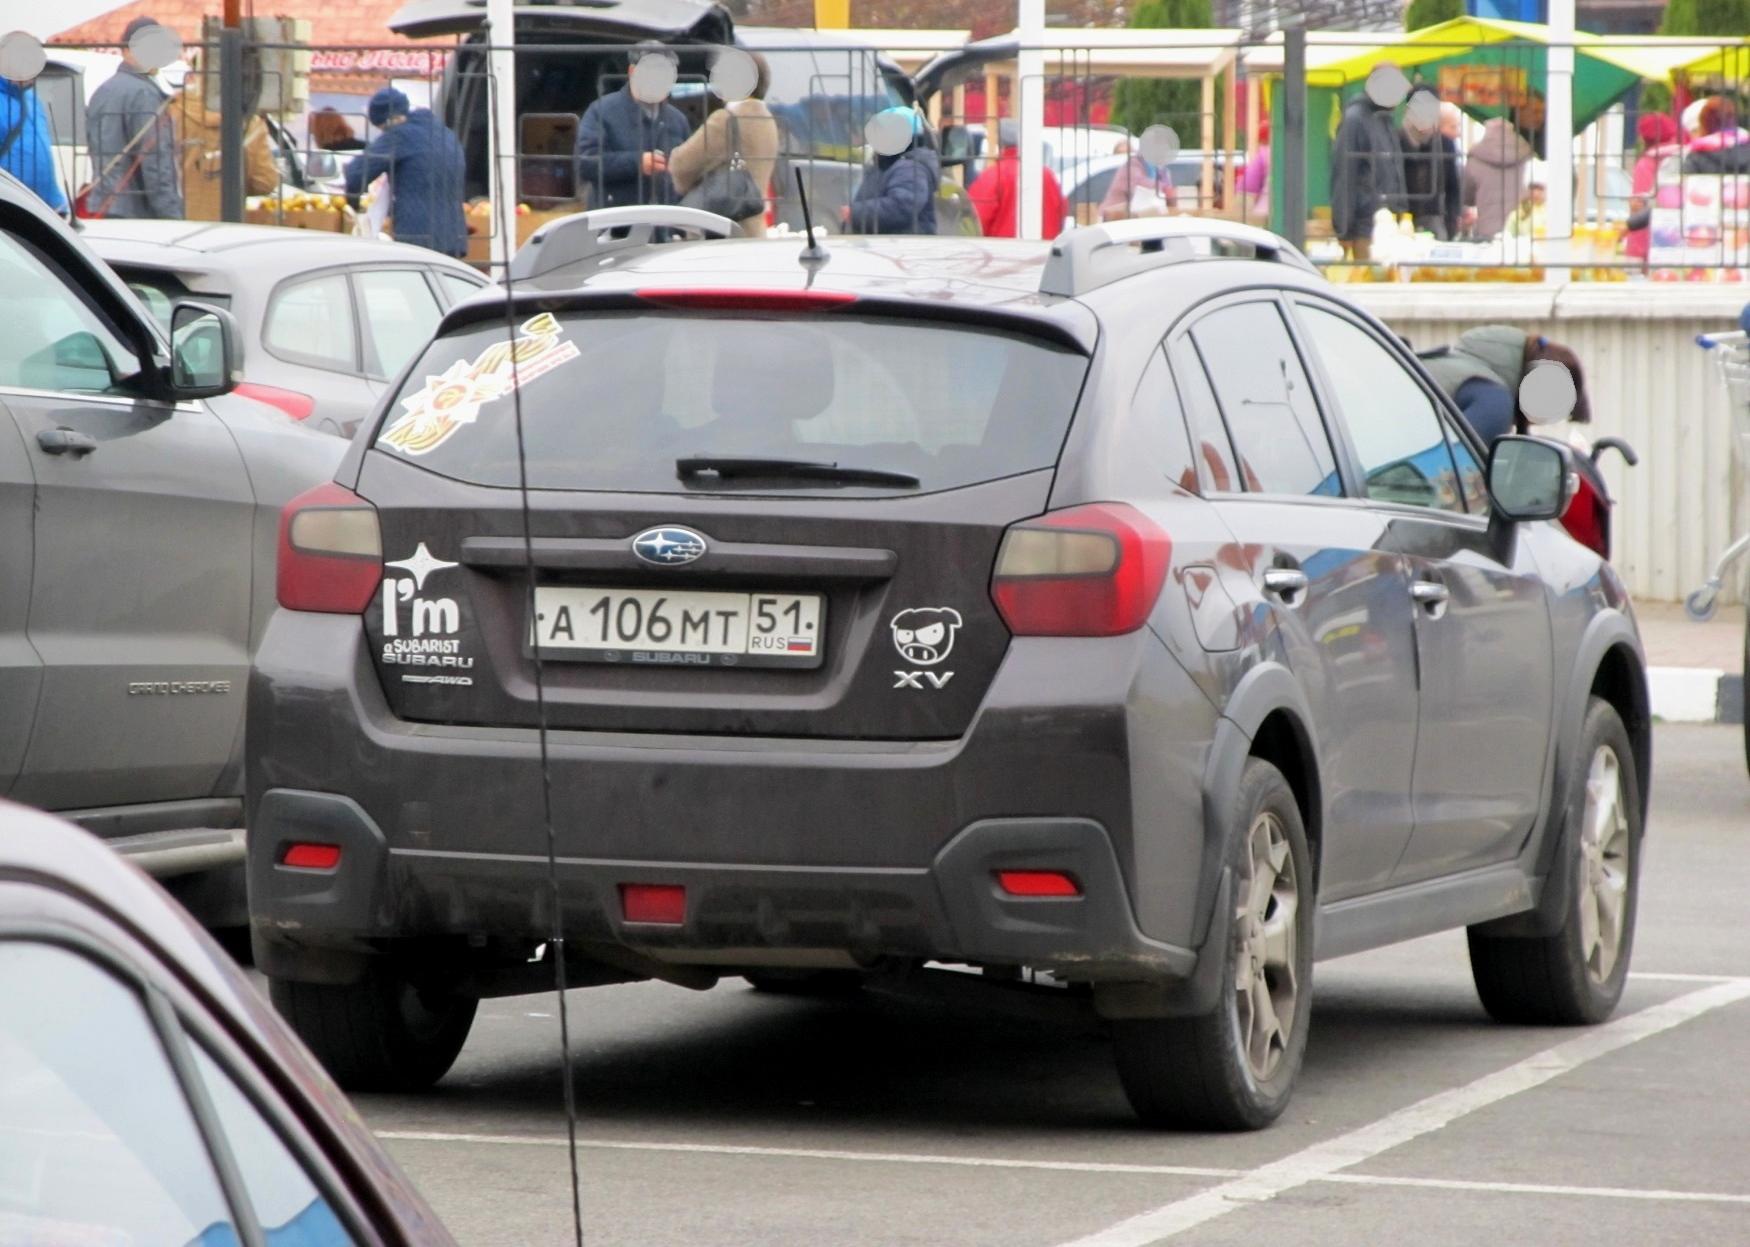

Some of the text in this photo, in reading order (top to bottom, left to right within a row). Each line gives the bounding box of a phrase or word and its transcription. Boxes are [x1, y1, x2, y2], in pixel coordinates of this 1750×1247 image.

[382, 577, 460, 637] I'm
[756, 599, 801, 635] 51
[393, 638, 460, 654] SUBARIST
[751, 636, 786, 650] RUS
[382, 653, 474, 669] SUBARU
[632, 651, 711, 665] SUBARU
[892, 670, 955, 690] XV
